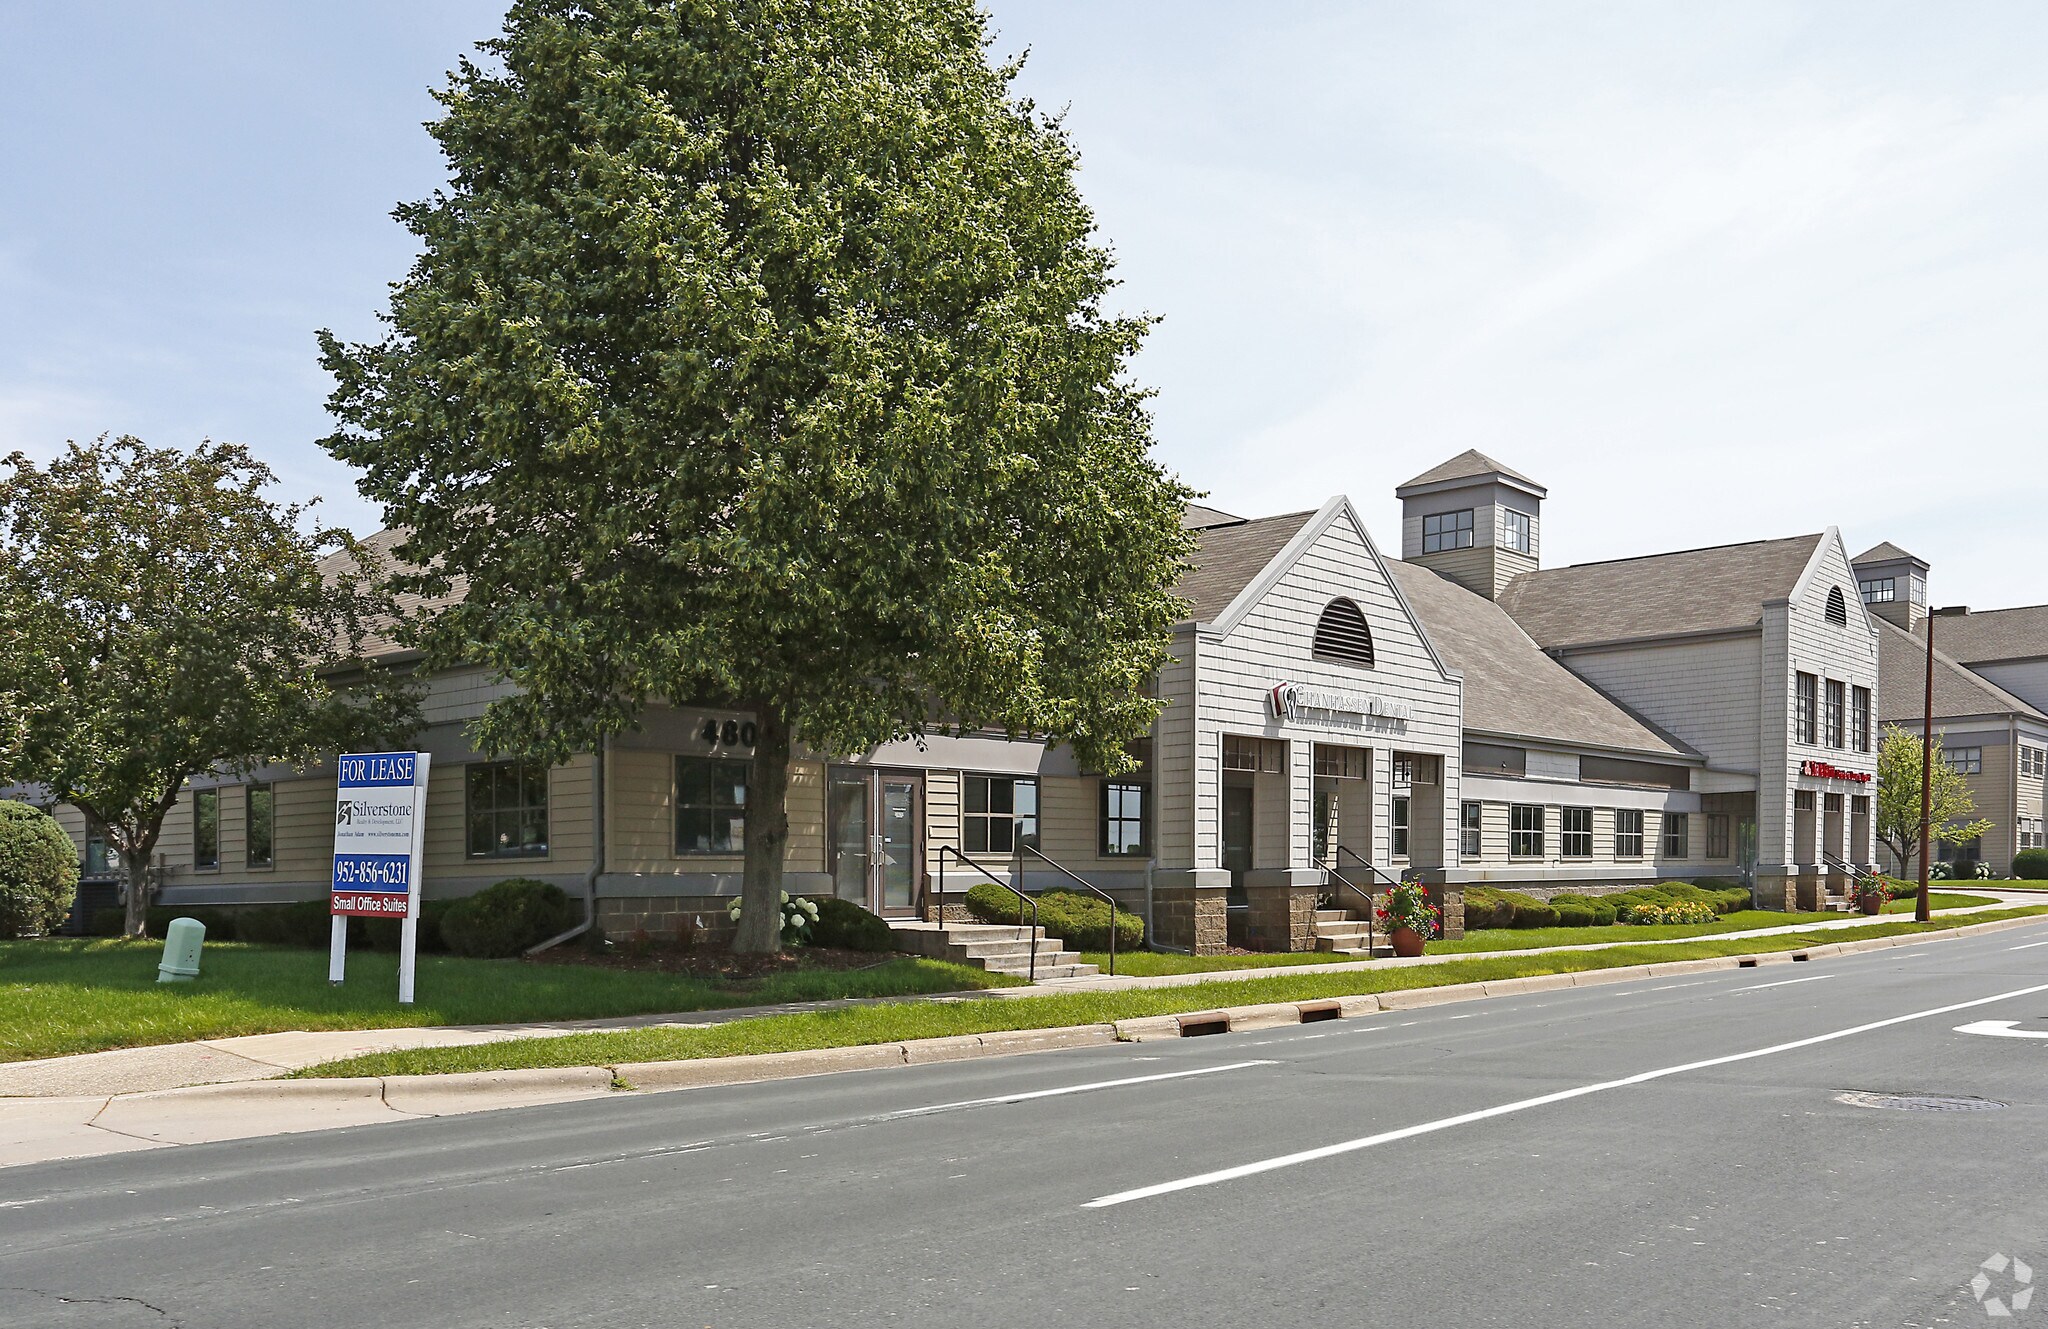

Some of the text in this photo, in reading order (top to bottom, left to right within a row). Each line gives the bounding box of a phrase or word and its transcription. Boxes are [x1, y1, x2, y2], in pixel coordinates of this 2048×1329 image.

[1374, 696, 1415, 720] DENTAL
[701, 719, 757, 748] 480
[341, 757, 413, 782] FOR LEASE
[352, 801, 412, 817] Silverstone
[336, 861, 407, 884] 952-856-6231
[333, 895, 407, 913] Small Office Suites
